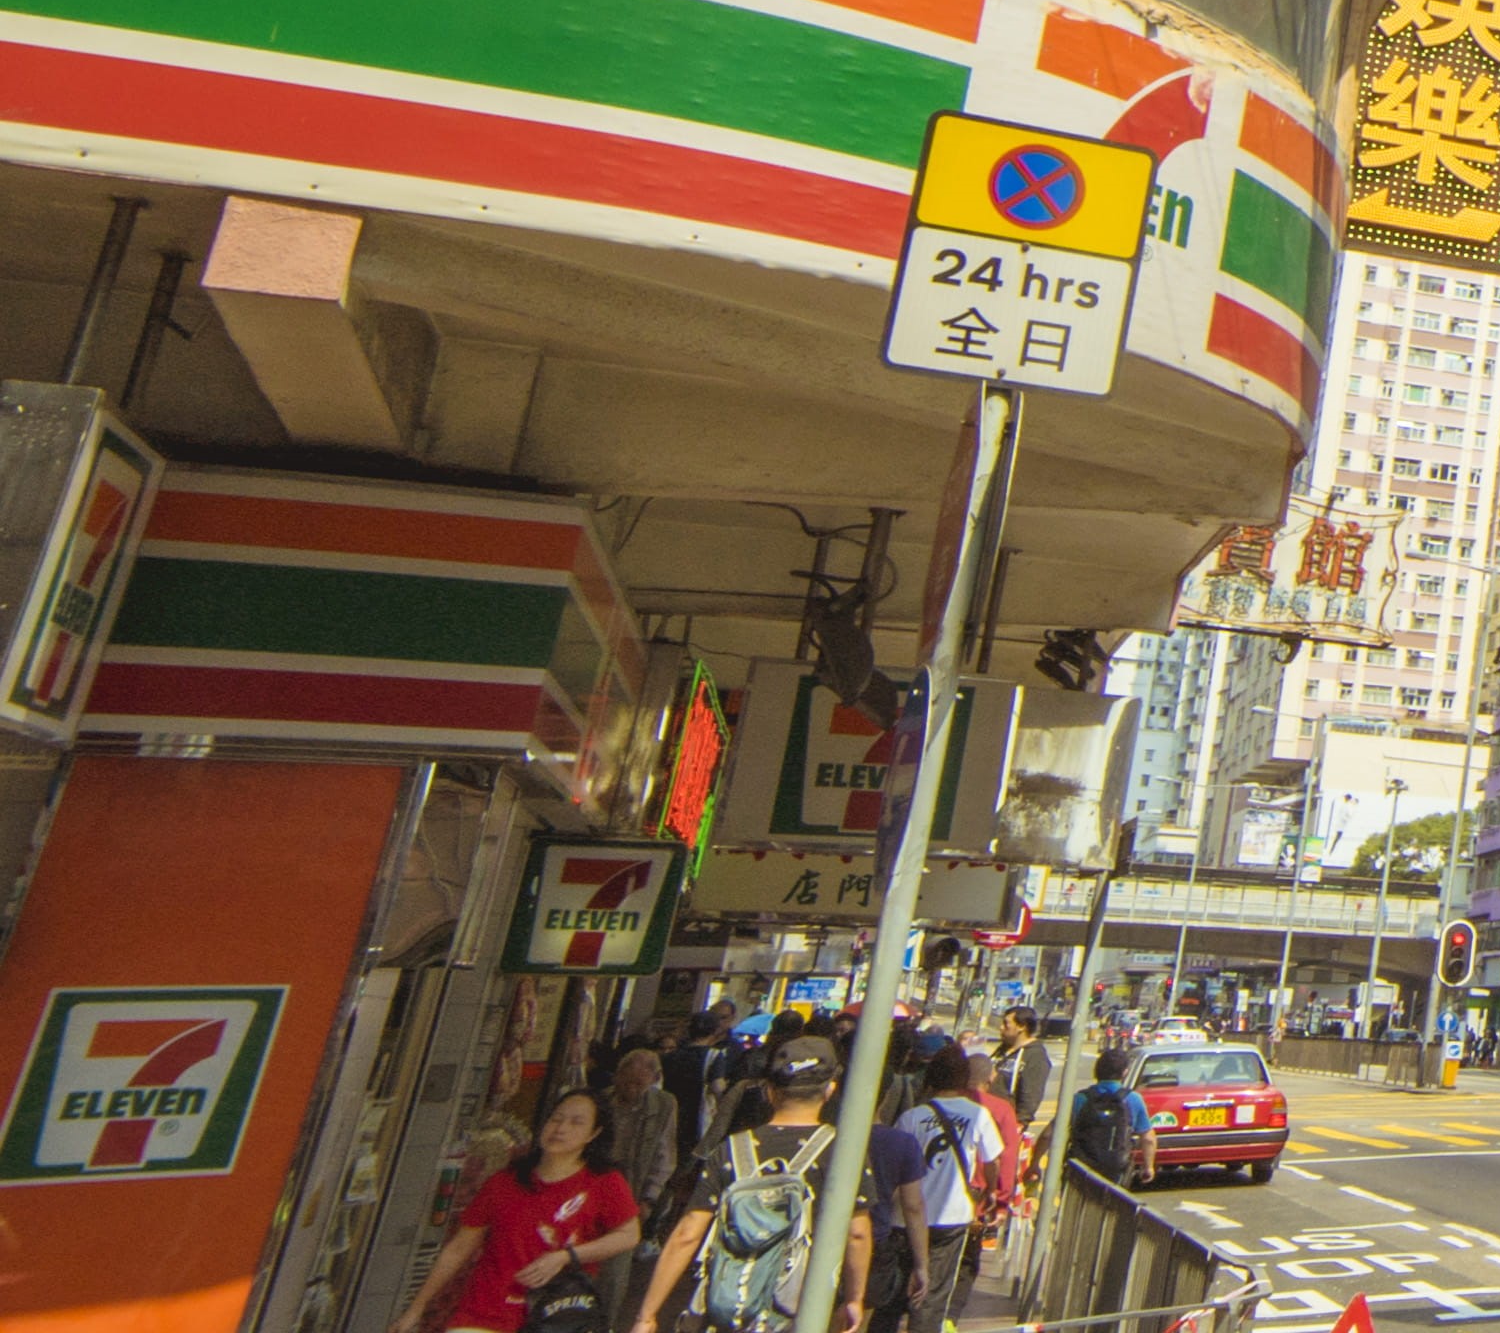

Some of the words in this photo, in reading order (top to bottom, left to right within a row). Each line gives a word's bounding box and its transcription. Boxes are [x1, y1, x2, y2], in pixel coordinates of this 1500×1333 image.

[932, 248, 1003, 293] 24
[1020, 263, 1100, 309] hrs
[934, 306, 1073, 373] 全日
[815, 763, 889, 789] ELEV
[1212, 1232, 1376, 1257] US
